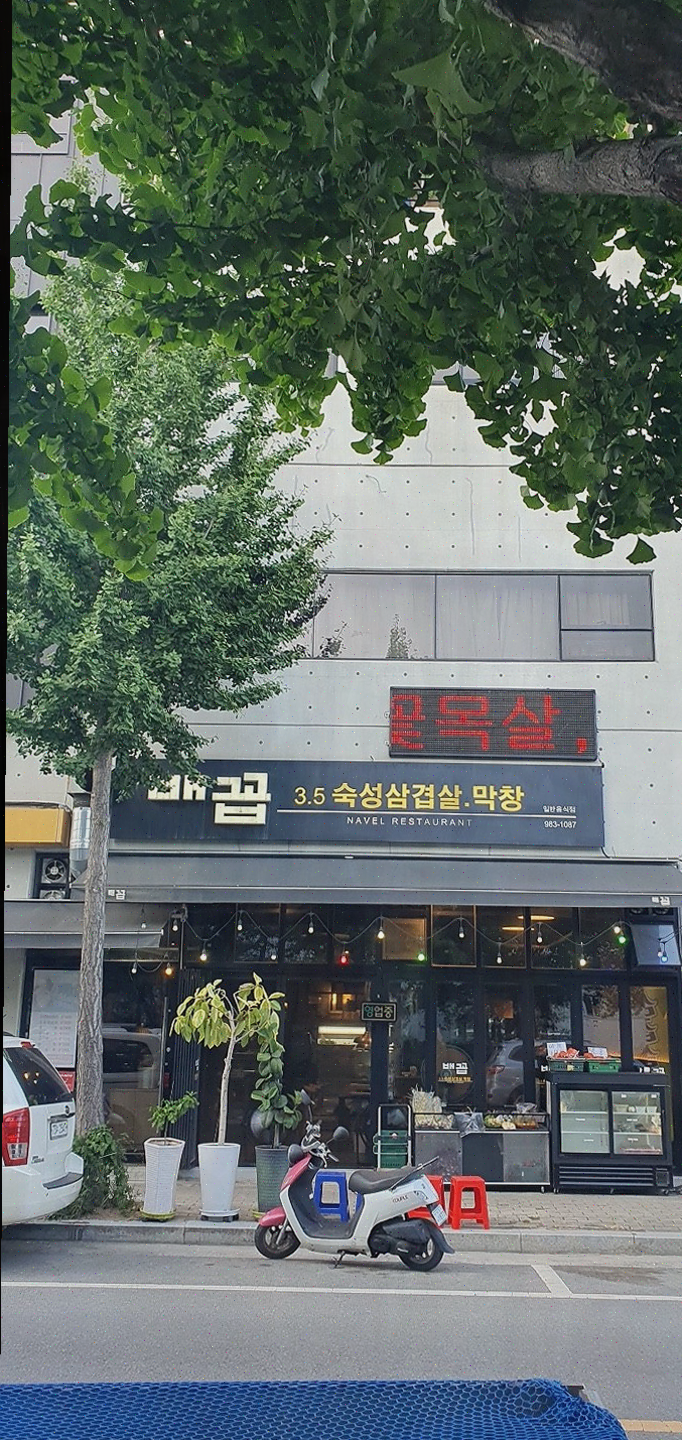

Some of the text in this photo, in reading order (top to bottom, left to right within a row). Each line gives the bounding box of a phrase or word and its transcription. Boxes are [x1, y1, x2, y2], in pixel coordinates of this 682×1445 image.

[294, 782, 525, 812] 3.5 숙성삼겹살.막창
[346, 816, 473, 827] NAVEL RESTAURANT
[364, 1005, 394, 1019] 영업중
[442, 1062, 469, 1075] 배꼽
